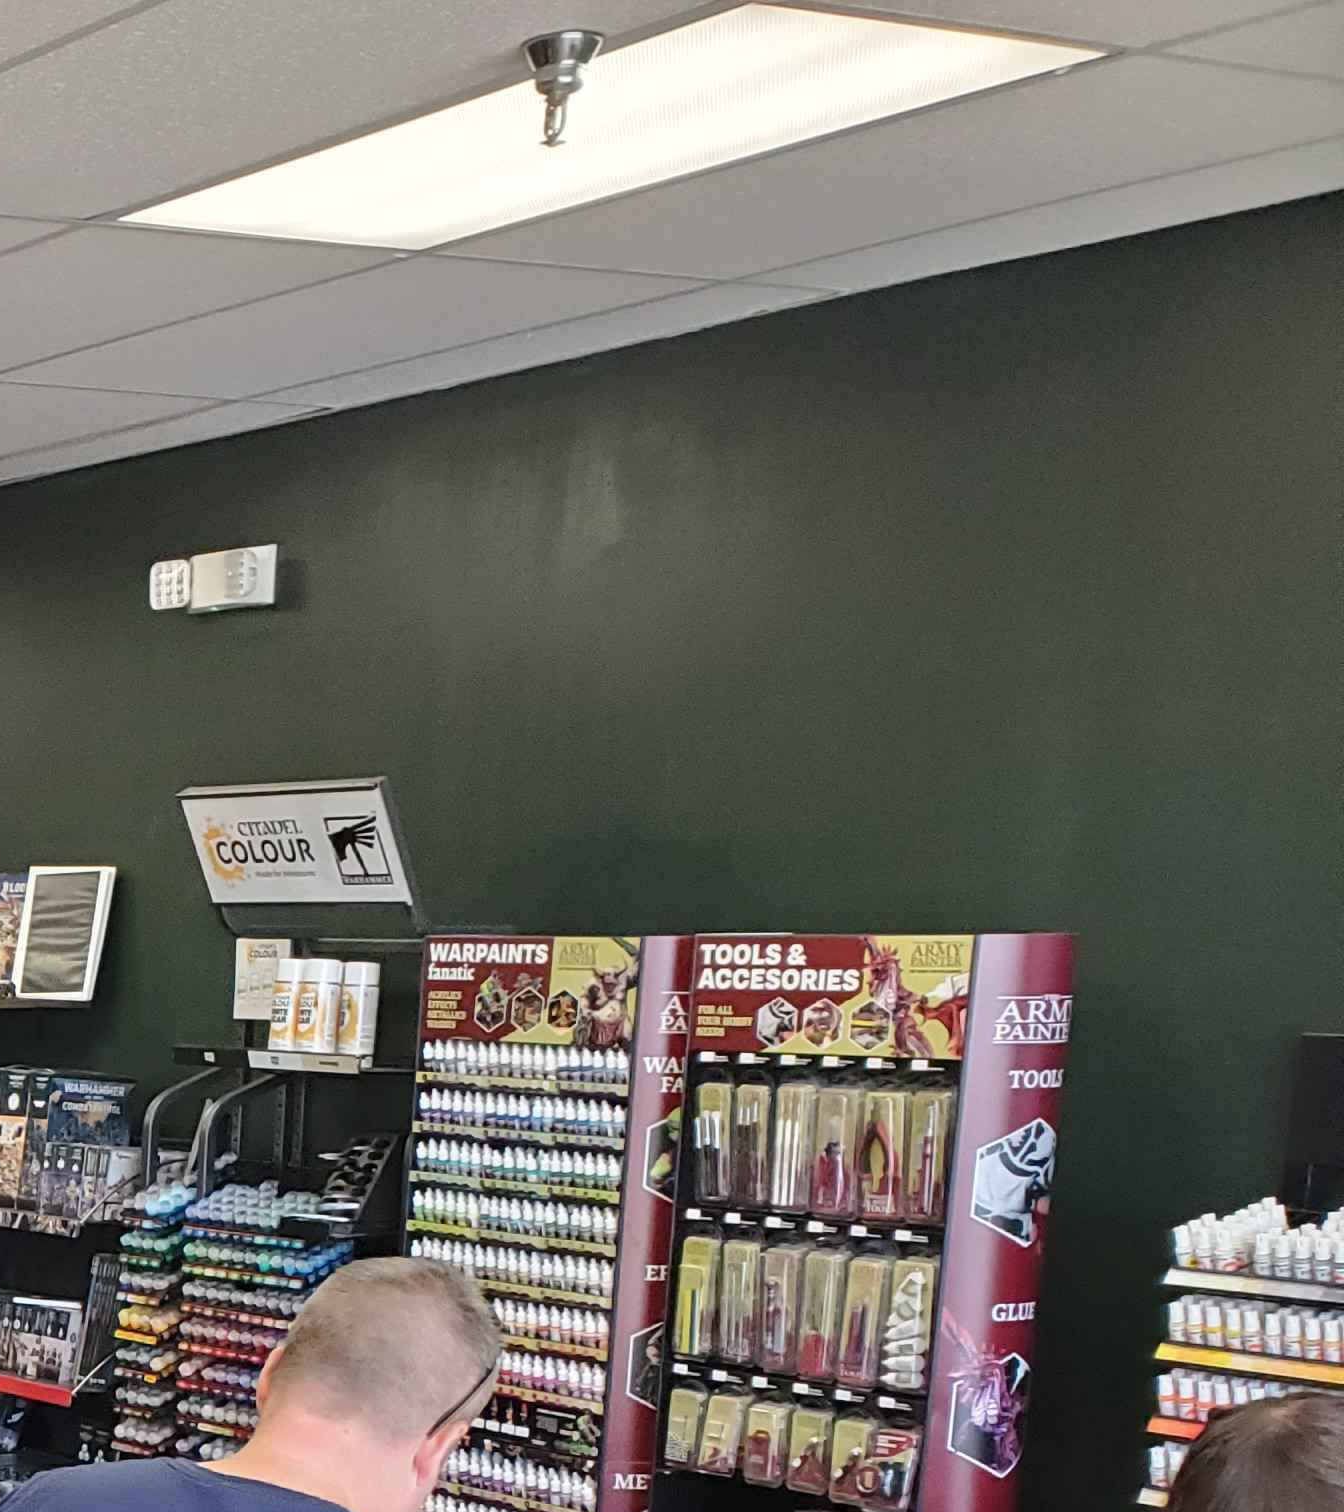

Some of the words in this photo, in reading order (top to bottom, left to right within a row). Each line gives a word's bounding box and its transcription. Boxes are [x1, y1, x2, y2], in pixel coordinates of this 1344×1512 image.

[237, 819, 303, 837] CITADEL
[216, 838, 316, 865] COLOUR
[430, 943, 548, 964] WARPAINTS
[700, 944, 783, 965] TOOLS
[786, 944, 806, 965] &
[912, 944, 961, 957] ARMY
[427, 964, 474, 980] fanatic
[698, 969, 860, 991] ACCESORIES
[1008, 1068, 1064, 1088] TOOLS
[64, 1082, 125, 1096] WARHAMMER
[991, 1302, 1036, 1322] GLUE
